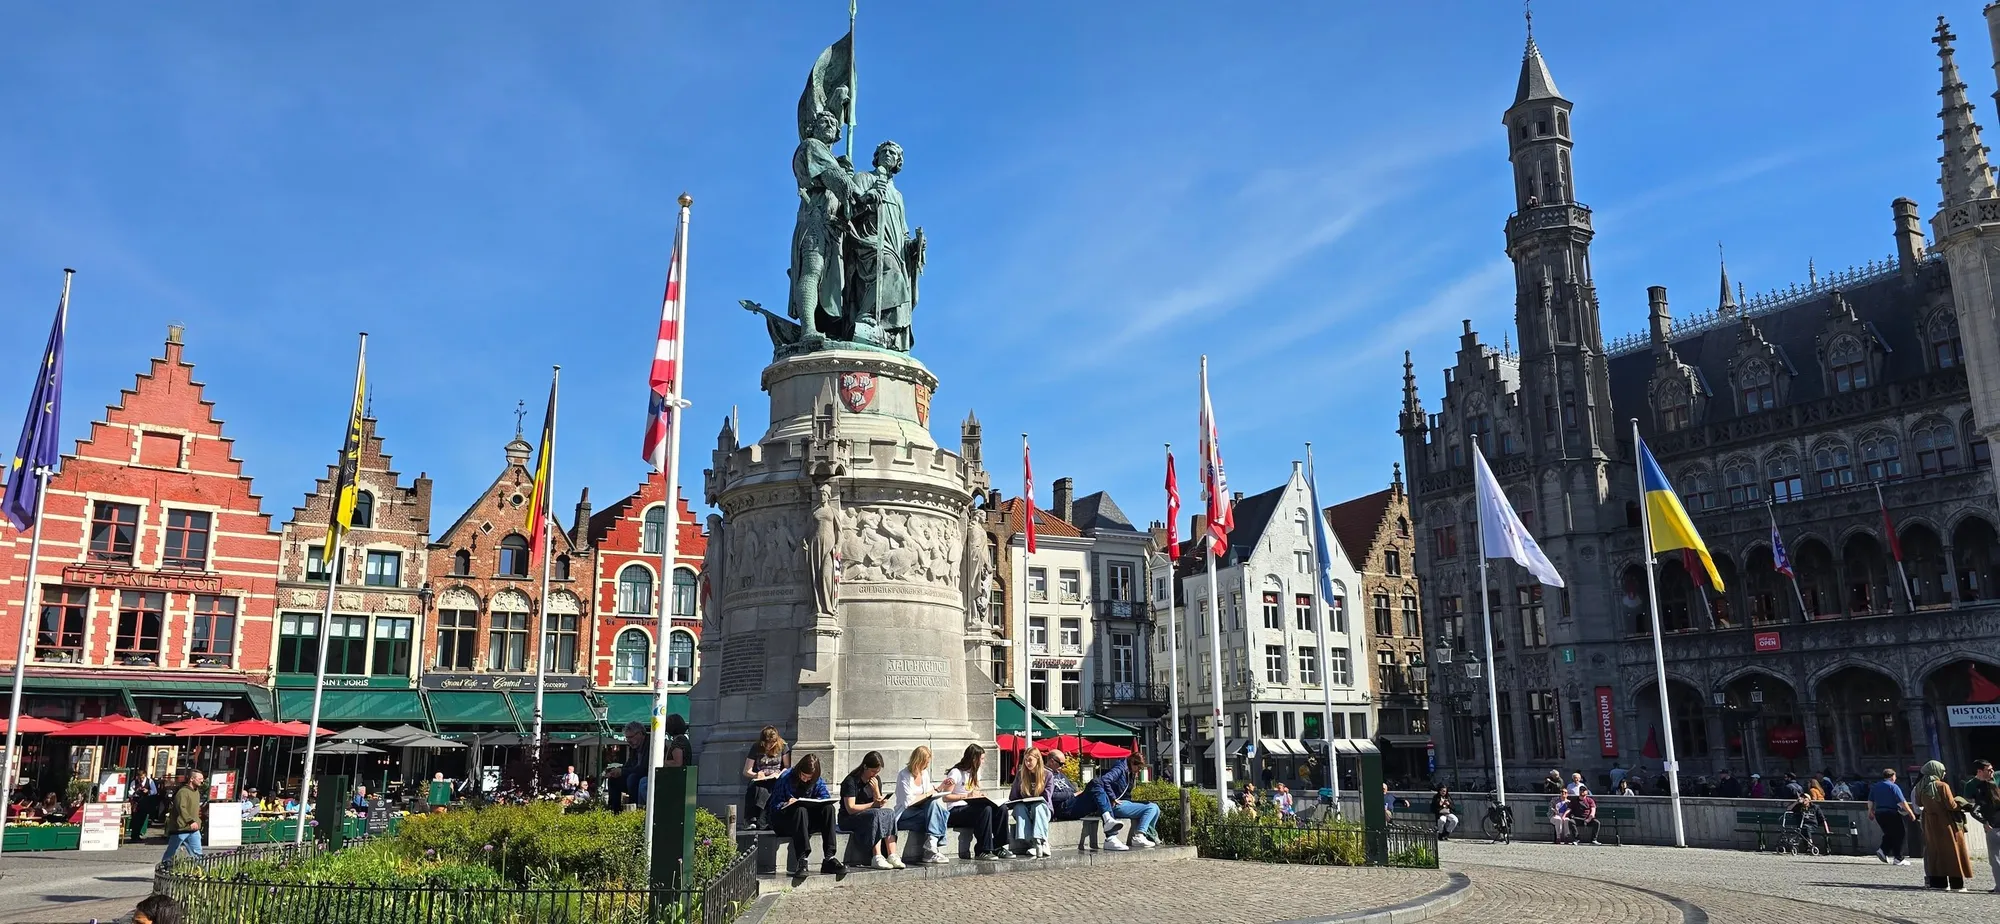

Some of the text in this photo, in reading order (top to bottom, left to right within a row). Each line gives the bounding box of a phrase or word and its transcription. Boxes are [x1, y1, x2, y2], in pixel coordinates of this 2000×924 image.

[71, 571, 219, 592] LE PANIER D'OR
[344, 679, 369, 687] JORIS
[440, 678, 463, 688] Grand
[492, 676, 522, 690] Central
[1600, 695, 1613, 748] HISTORIUM
